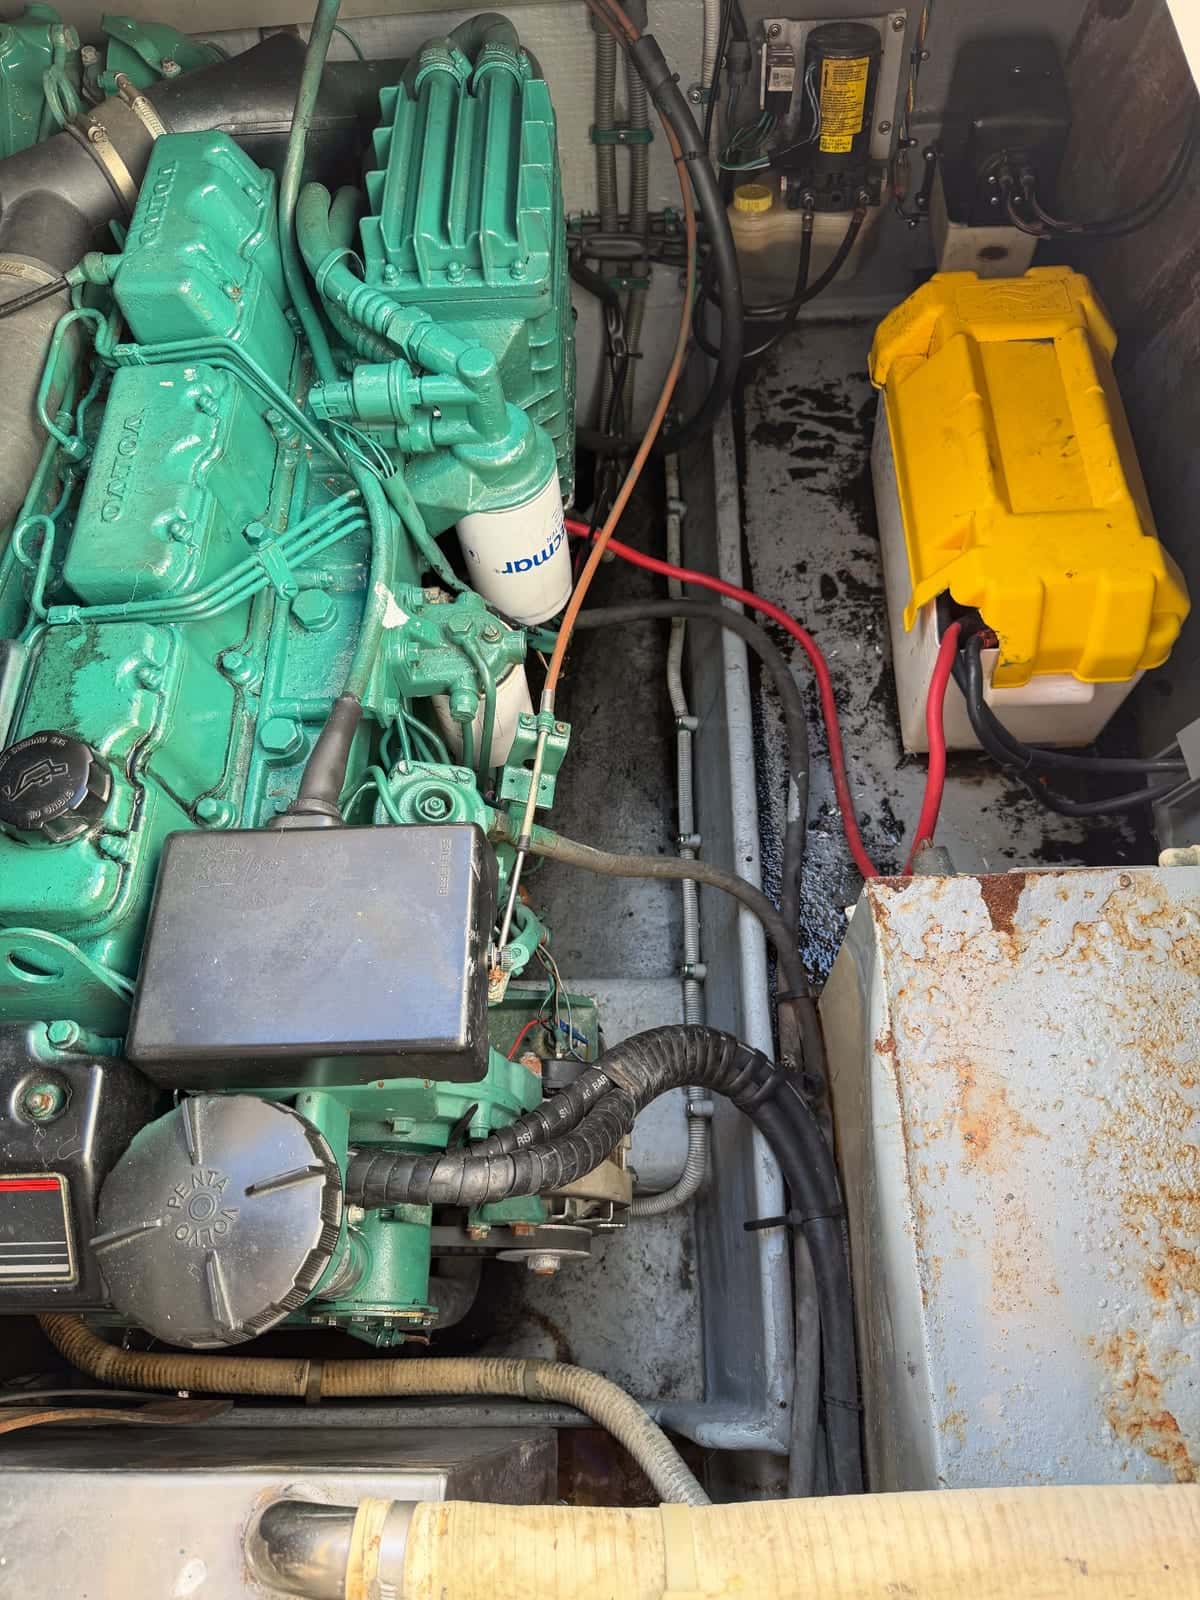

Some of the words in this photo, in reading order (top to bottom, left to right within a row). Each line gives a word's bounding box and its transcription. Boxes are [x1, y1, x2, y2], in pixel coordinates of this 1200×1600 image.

[100, 410, 143, 522] VOLVO
[168, 1168, 229, 1208] PENTA
[175, 1207, 240, 1246] VOLVO
